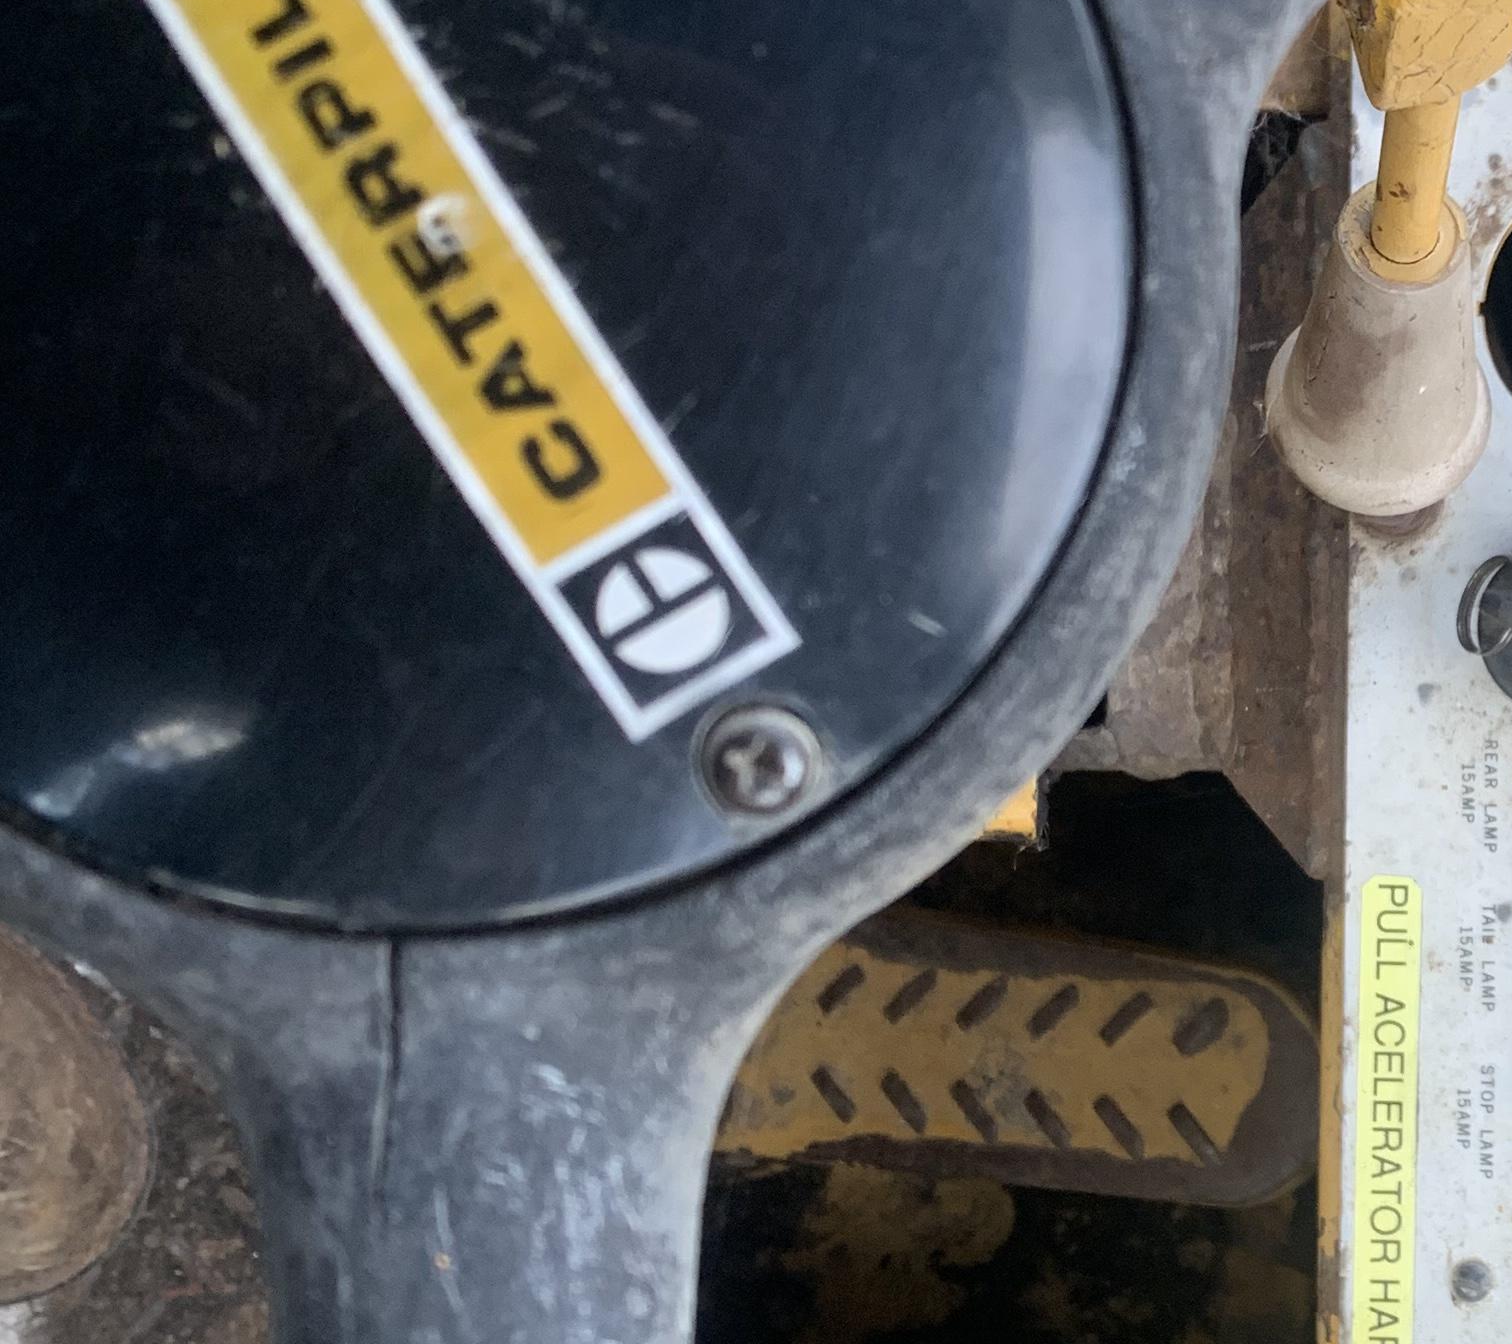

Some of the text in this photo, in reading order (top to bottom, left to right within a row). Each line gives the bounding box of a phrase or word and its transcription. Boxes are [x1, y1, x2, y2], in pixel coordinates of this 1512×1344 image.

[1460, 762, 1477, 824] 15AMP
[1483, 738, 1499, 854] REAR LAMP
[1373, 882, 1410, 981] PULL
[1458, 924, 1474, 988] 15AMP
[1480, 903, 1496, 1013] TAIL LAMP
[1368, 993, 1408, 1261] ACELERATOR
[1456, 1087, 1472, 1150] 15AMP
[1479, 1064, 1495, 1181] STOP LAMP
